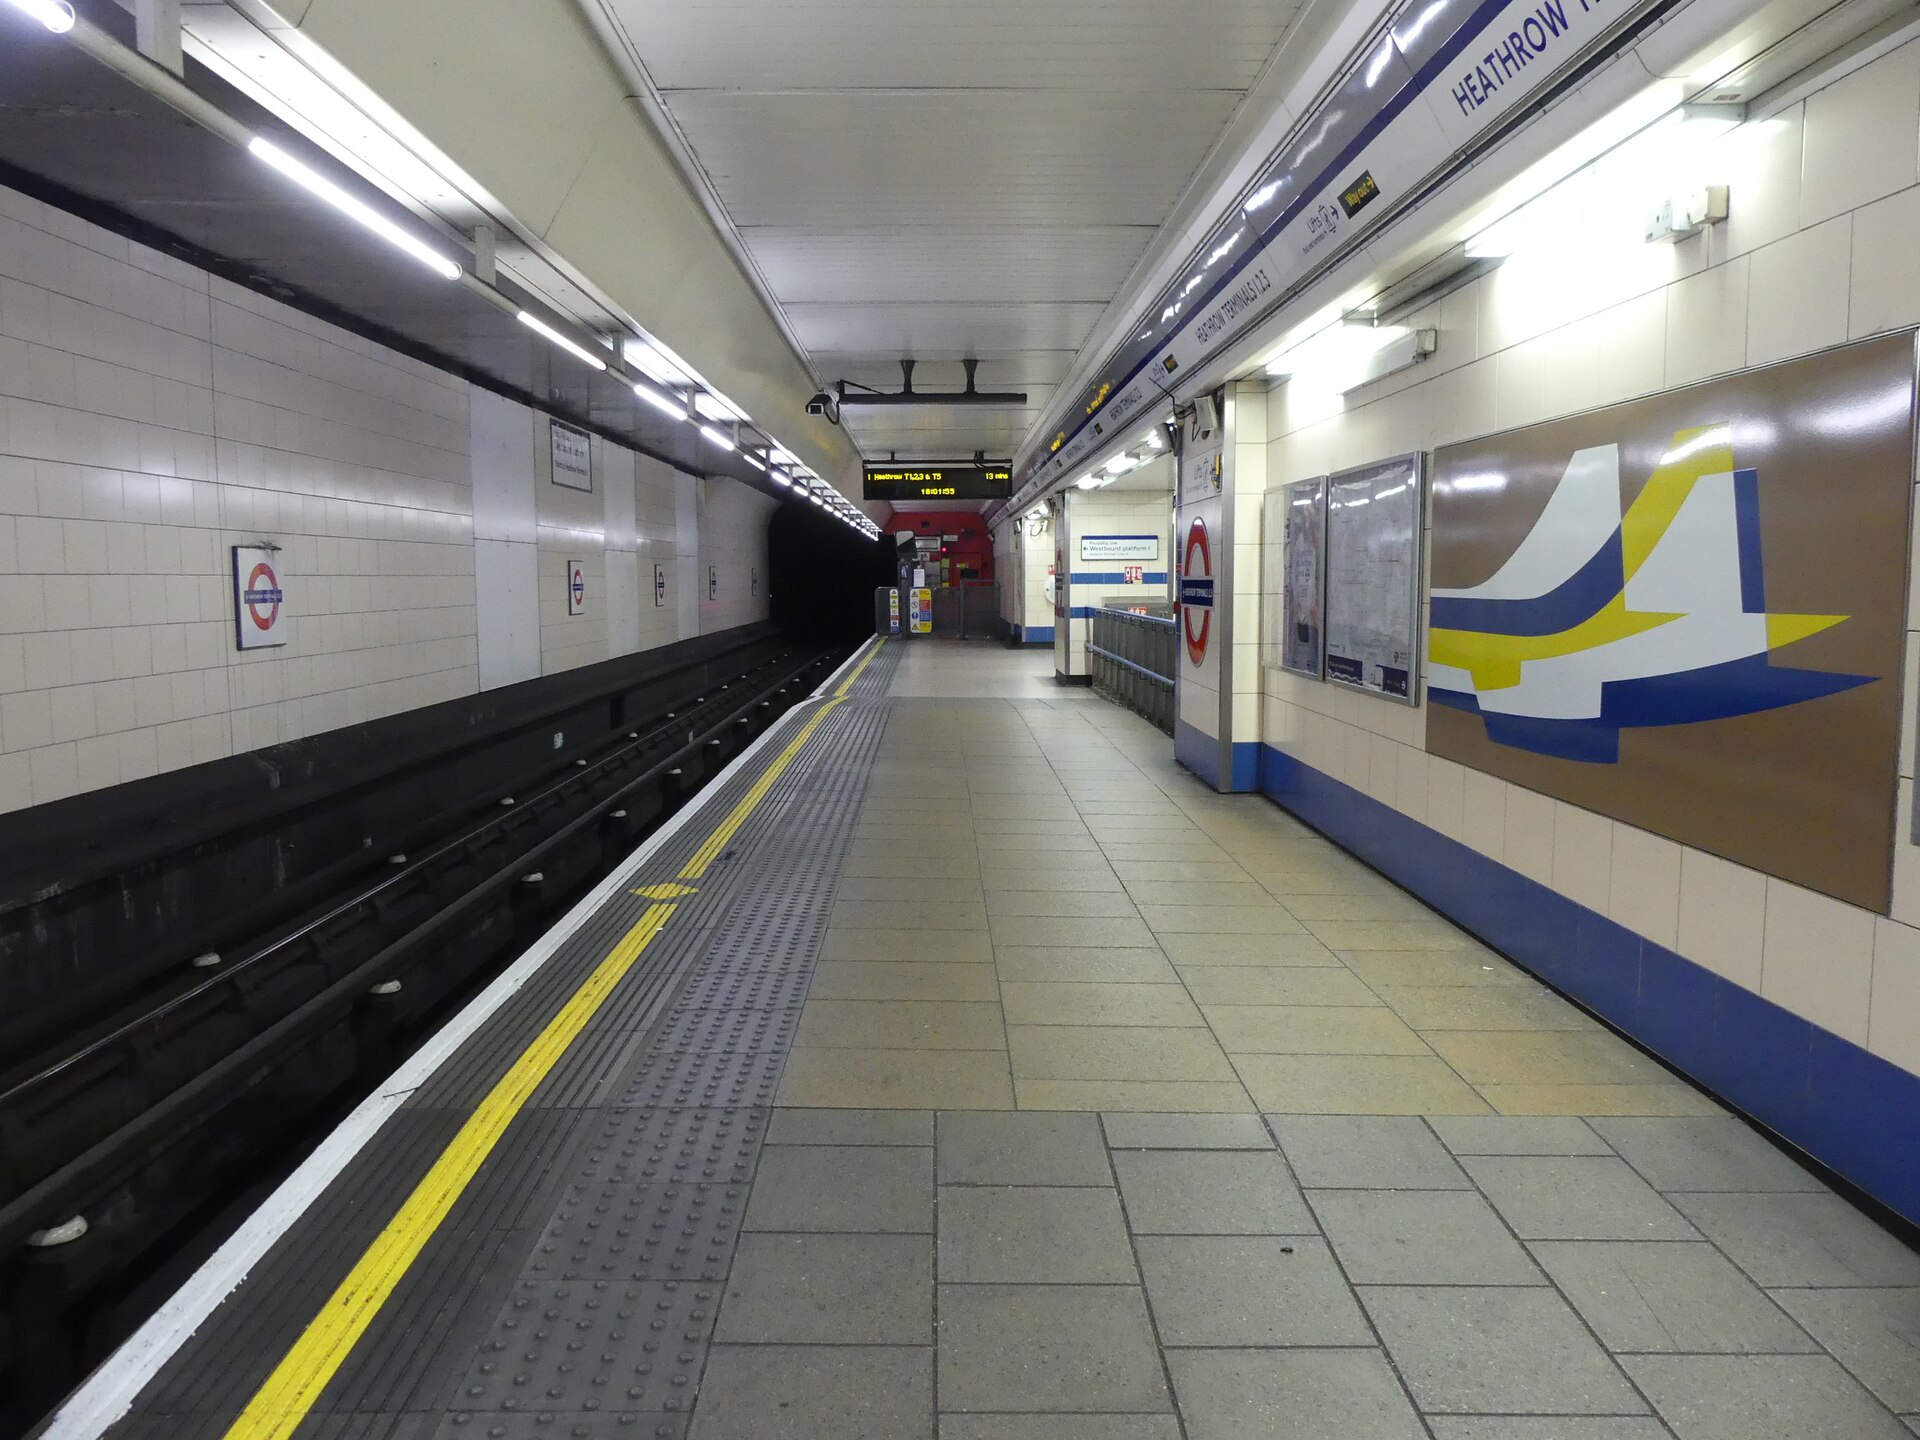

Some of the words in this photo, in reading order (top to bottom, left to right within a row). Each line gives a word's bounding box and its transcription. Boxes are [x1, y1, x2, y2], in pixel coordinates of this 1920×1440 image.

[1451, 0, 1569, 117] HEATHROW
[1345, 191, 1361, 207] Way
[1357, 182, 1370, 198] out
[1195, 308, 1227, 345] HEATHROW
[1221, 281, 1257, 320] TERMINALS
[873, 473, 903, 481] Heathrow
[932, 472, 942, 480] T5
[985, 472, 994, 480] 13
[995, 472, 1009, 480] mins
